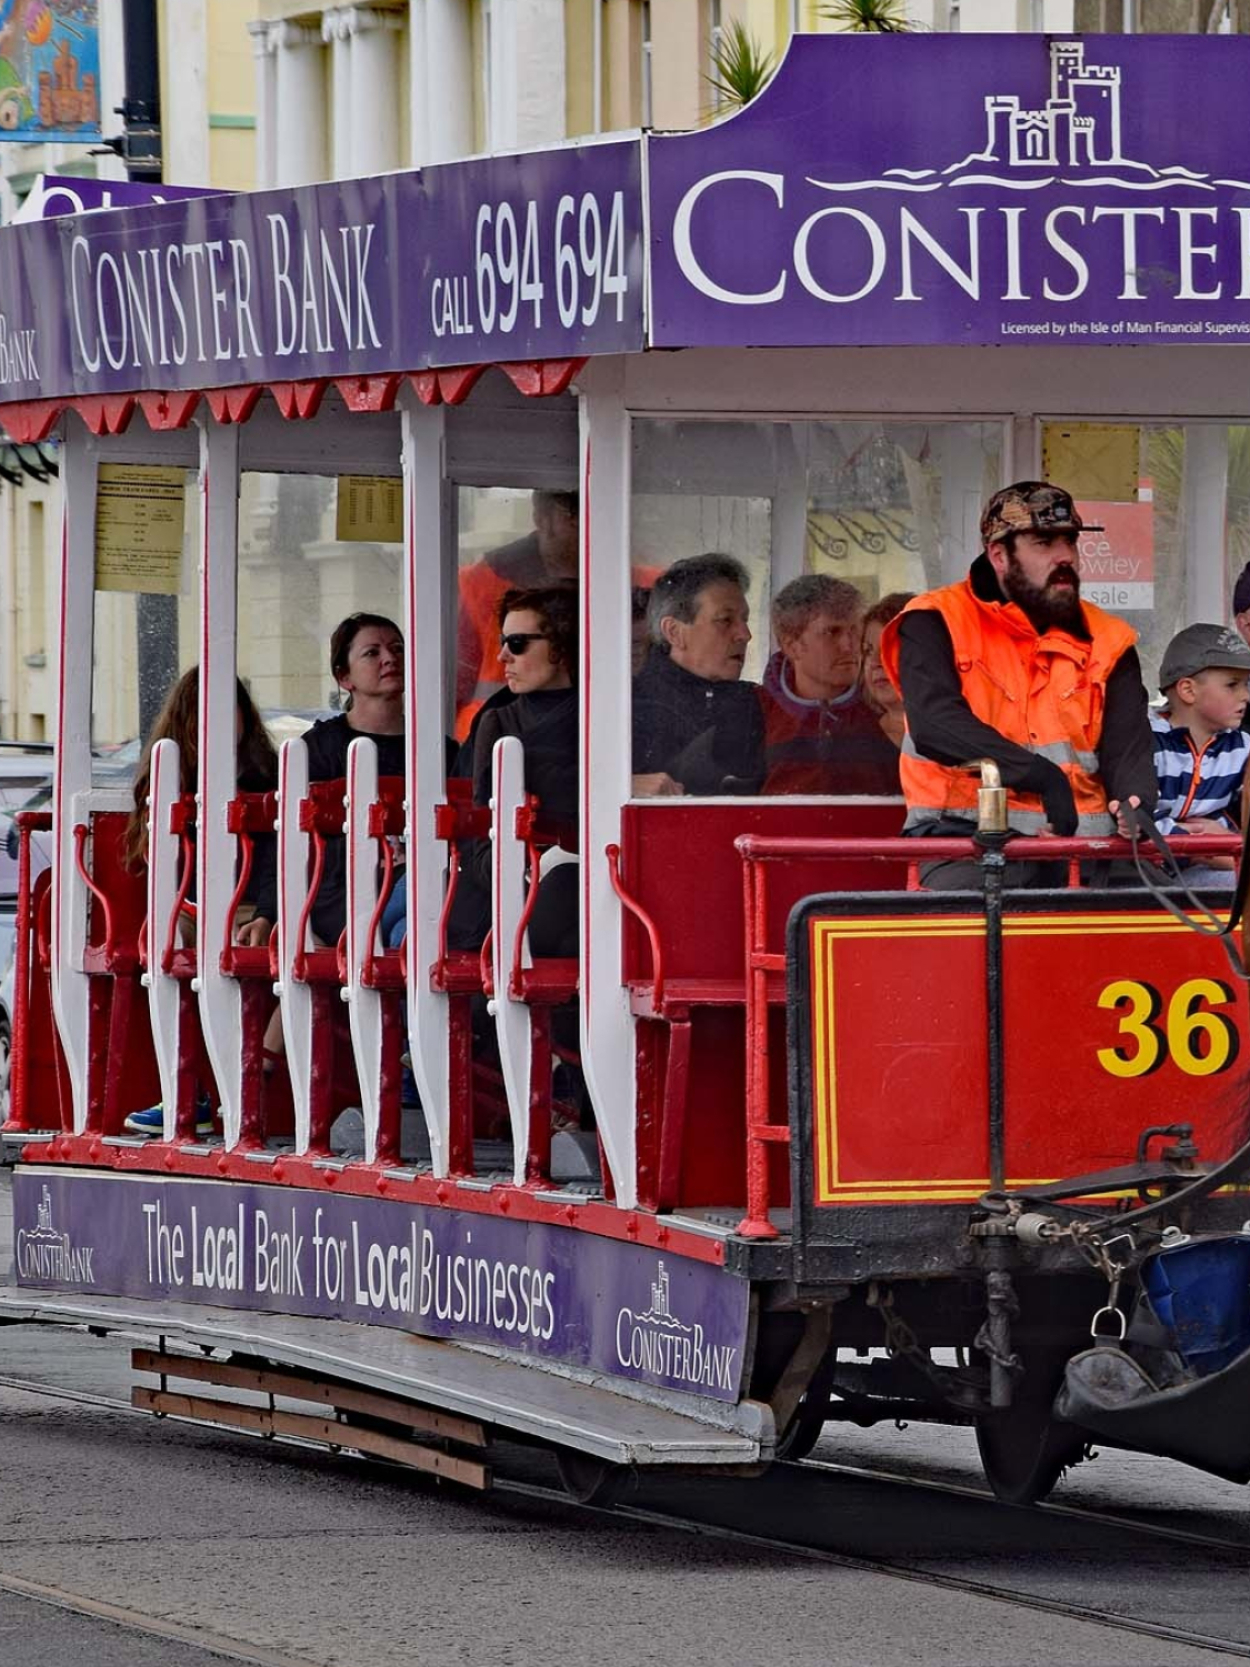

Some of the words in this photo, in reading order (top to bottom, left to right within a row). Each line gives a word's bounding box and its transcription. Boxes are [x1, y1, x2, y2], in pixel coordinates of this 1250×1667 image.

[267, 213, 382, 355] BANK
[431, 276, 474, 337] CALL
[476, 200, 544, 334] 694
[555, 191, 628, 329] 694
[1001, 321, 1050, 334] Licensed
[1051, 321, 1067, 336] by
[1069, 321, 1089, 334] the
[1090, 321, 1109, 333] Isle
[1111, 321, 1124, 333] of
[1127, 321, 1152, 333] Man
[1155, 321, 1202, 333] Financial
[1090, 586, 1129, 605] sale
[1097, 978, 1236, 1078] 36
[142, 1199, 185, 1286] The
[191, 1203, 244, 1291] Local
[255, 1206, 304, 1297] Bank
[312, 1207, 347, 1302] for
